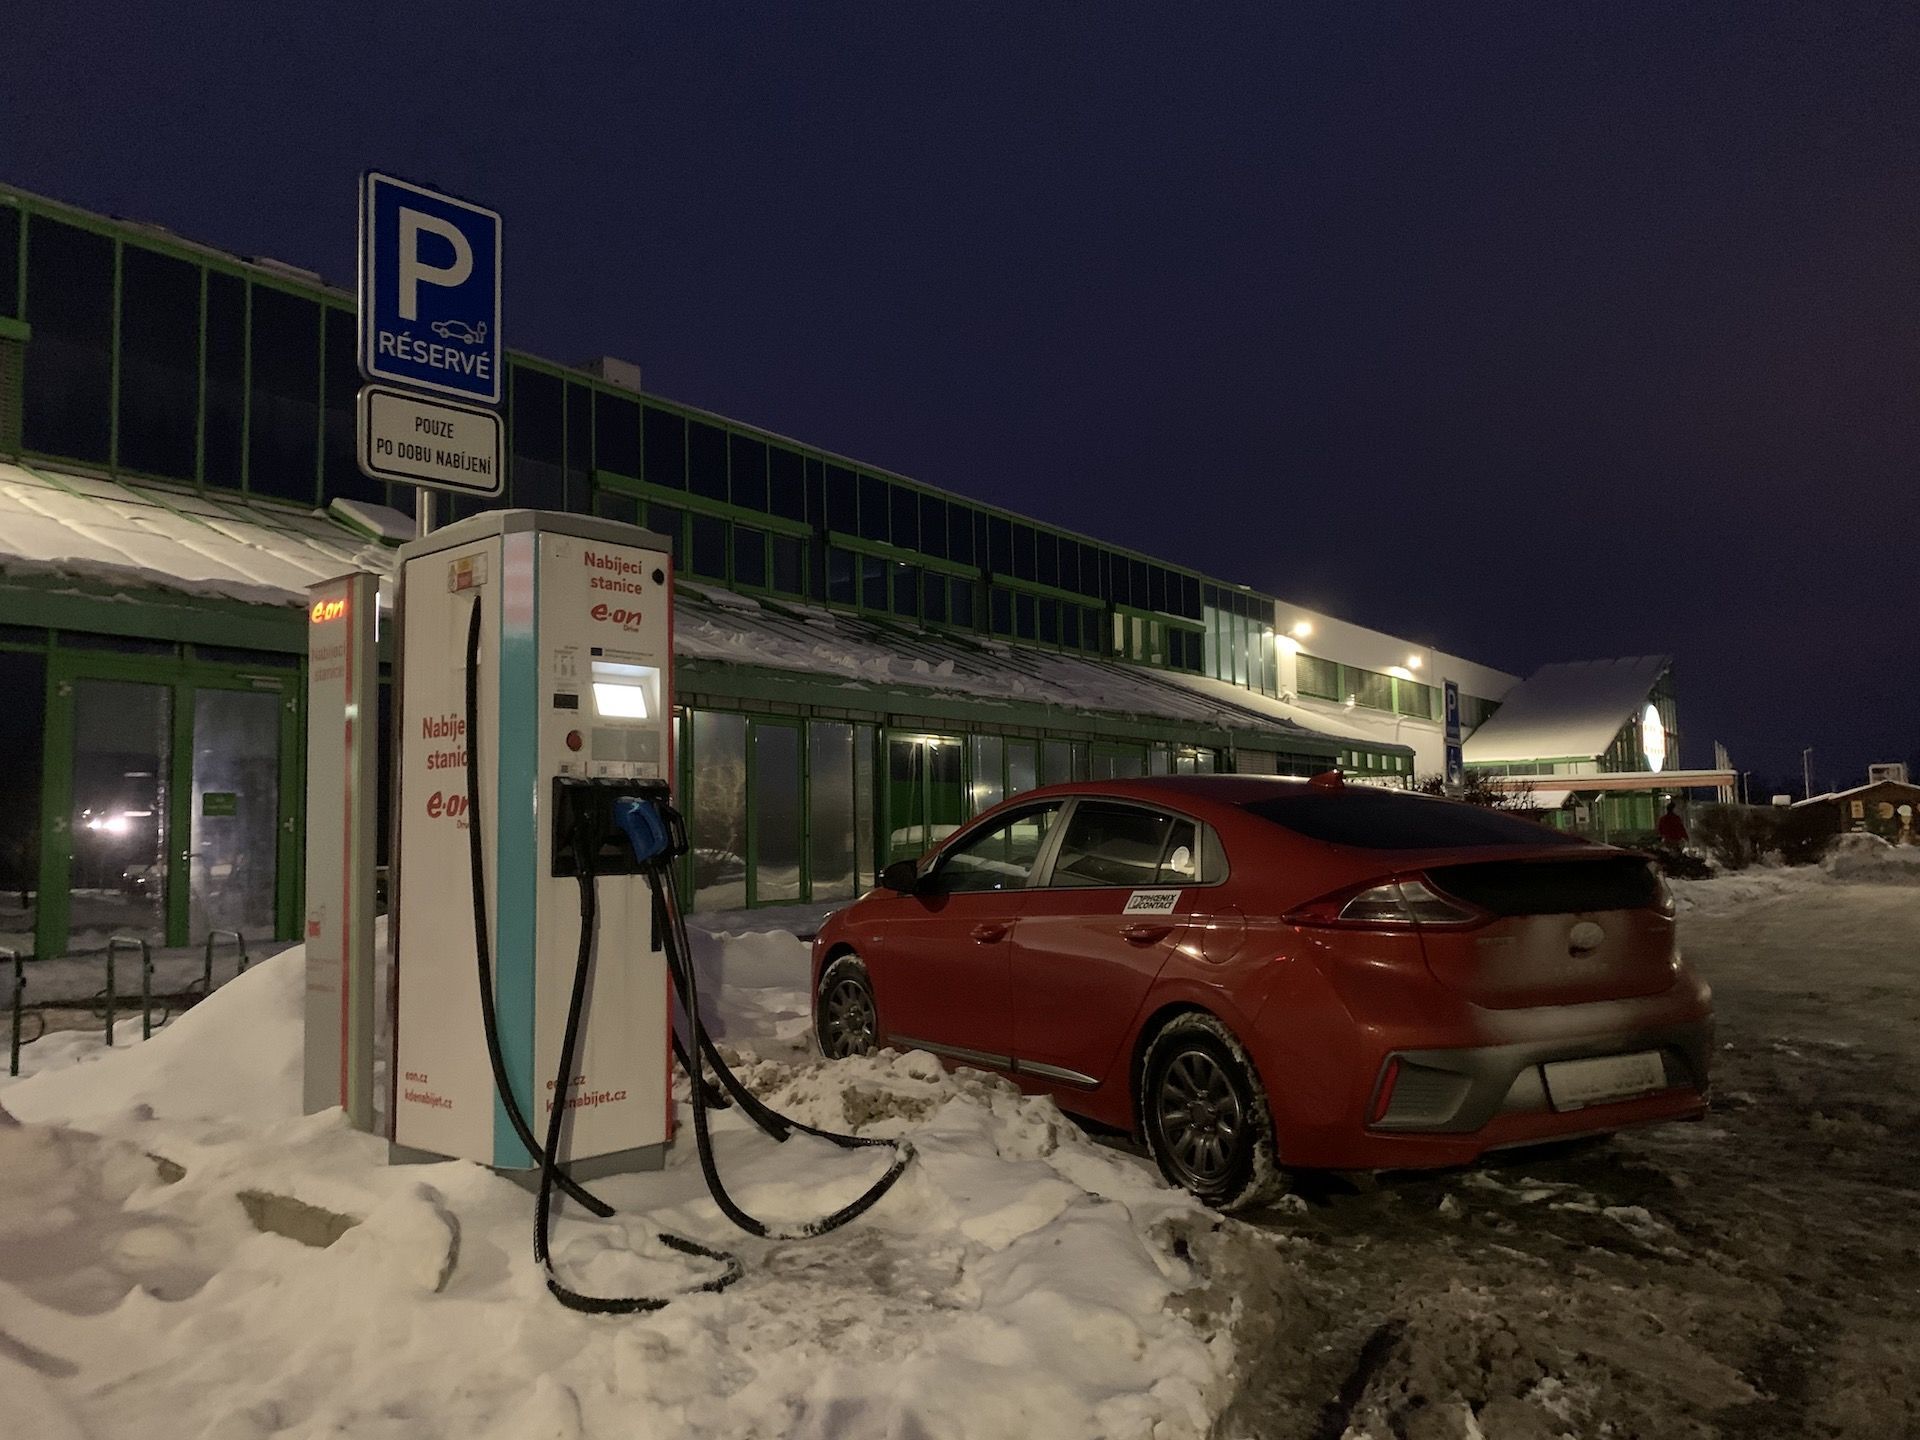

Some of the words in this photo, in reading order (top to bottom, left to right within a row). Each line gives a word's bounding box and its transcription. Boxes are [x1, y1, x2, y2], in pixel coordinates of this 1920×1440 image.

[398, 206, 473, 321] P
[378, 330, 491, 380] RÉSERVÉ
[415, 416, 455, 439] POUZE
[376, 438, 393, 456] PO
[397, 442, 432, 463] DOBU
[436, 451, 492, 475] NABÍJENÍ
[590, 576, 643, 595] stanice
[427, 745, 469, 770] stanic
